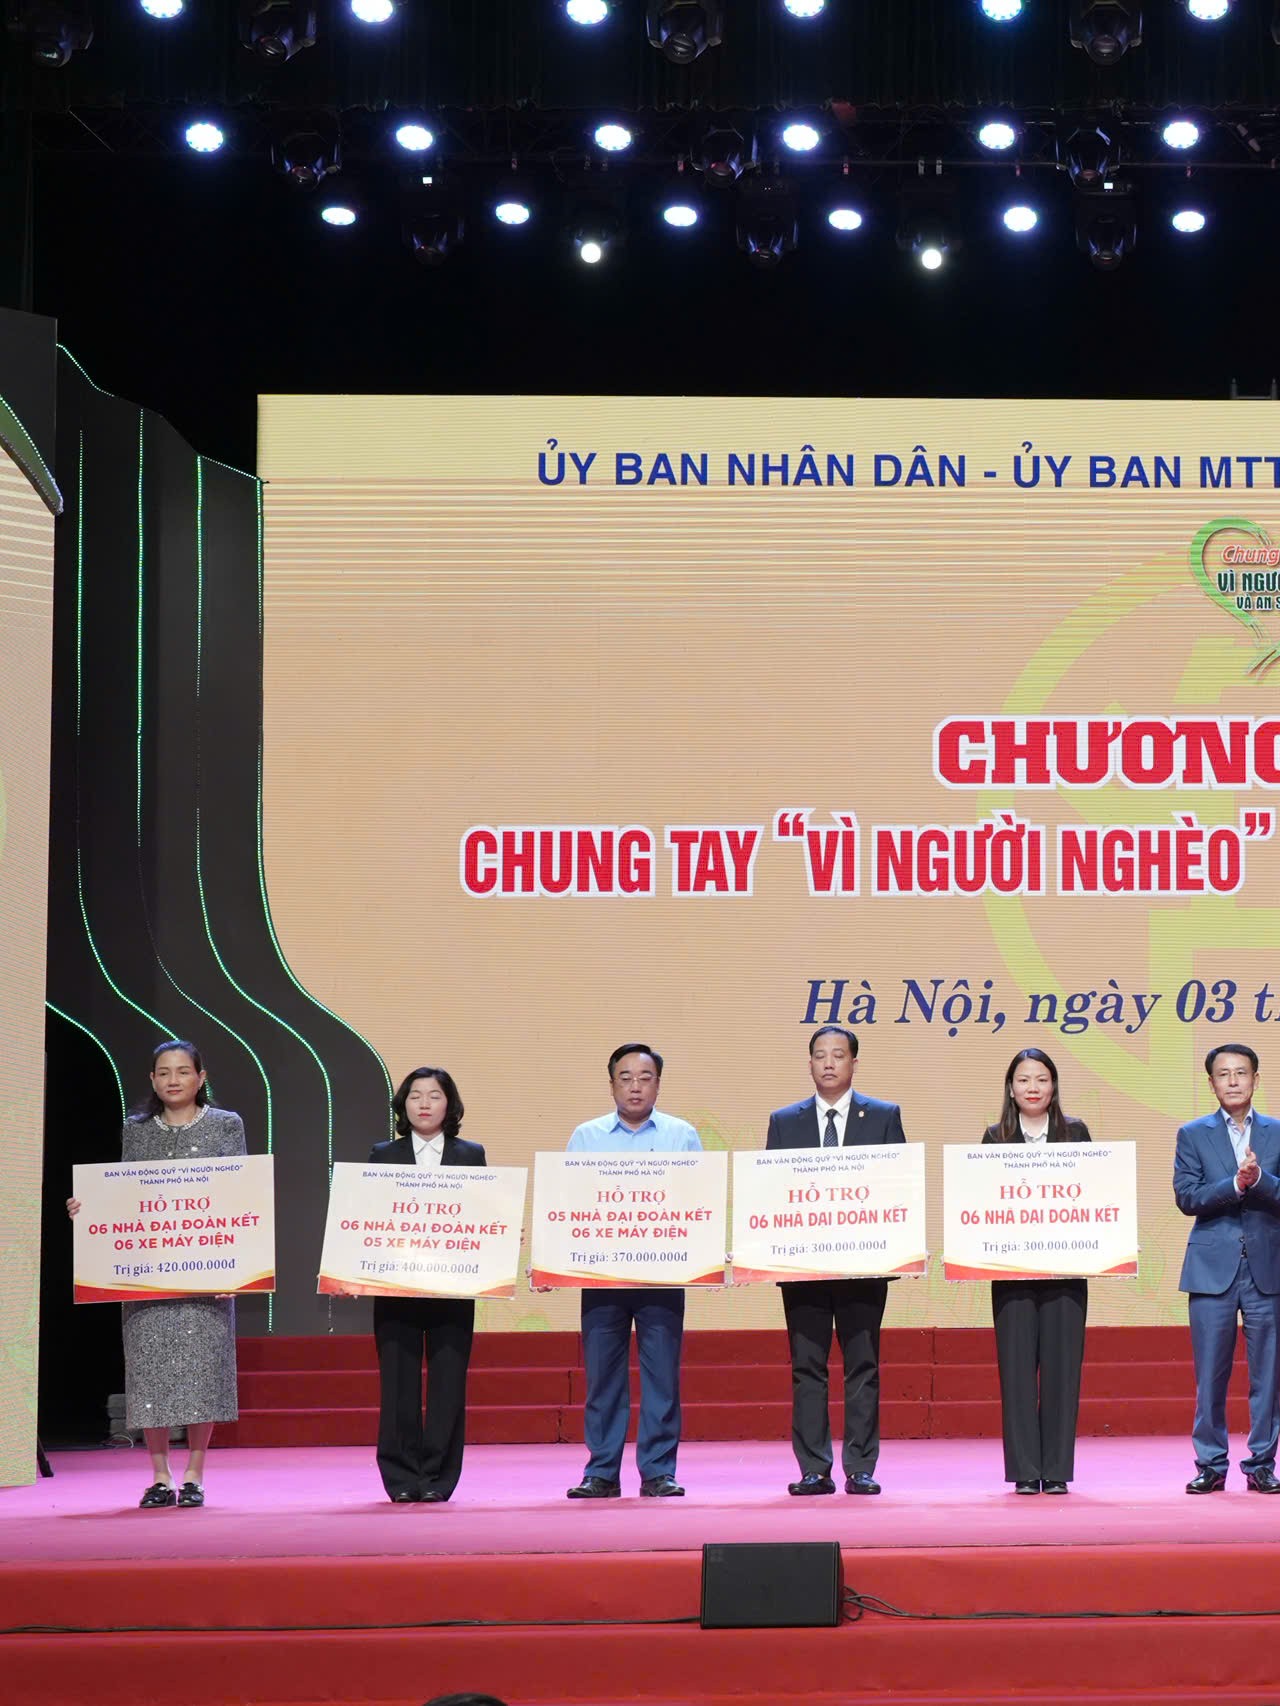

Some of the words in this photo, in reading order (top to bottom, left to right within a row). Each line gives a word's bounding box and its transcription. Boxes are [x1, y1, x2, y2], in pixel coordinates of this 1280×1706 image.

[538, 438, 597, 486] ỦY
[615, 452, 708, 486] BAN
[727, 444, 854, 486] NHÂN
[874, 445, 966, 487] DÂN
[1013, 441, 1072, 488] ỦY
[1089, 455, 1181, 488] BAN
[1222, 545, 1279, 565] Chung
[1217, 569, 1234, 592] VÌ
[1237, 594, 1252, 609] VÀ
[1257, 597, 1271, 609] AN
[463, 829, 651, 893] CHUNG
[669, 829, 757, 892] TAY
[877, 814, 1041, 894] NGƯỜI
[799, 979, 877, 1024] Hà
[895, 979, 1006, 1037] Nội,
[1024, 978, 1162, 1034] ngày
[1176, 979, 1237, 1023] 03
[598, 1185, 625, 1203] HỖ
[629, 1189, 666, 1205] TRỢ
[788, 1182, 820, 1203] HỖ
[825, 1185, 870, 1203] TRỢ
[1000, 1178, 1032, 1200] HỖ
[1037, 1182, 1082, 1201] TRỢ
[140, 1194, 167, 1213] HỖ
[172, 1196, 211, 1212] TRỢ
[392, 1197, 420, 1214] HỖ
[424, 1201, 462, 1218] TRỢ
[89, 1223, 107, 1235] 06
[113, 1219, 145, 1233] NHÀ
[150, 1219, 176, 1233] ĐẠI
[181, 1216, 226, 1230] ĐOÀN
[231, 1212, 259, 1227] KẾT
[548, 1211, 566, 1221] 05
[571, 1208, 601, 1221] NHÀ
[606, 1211, 632, 1224] ĐẠI
[637, 1208, 680, 1221] ĐOÀN
[685, 1206, 712, 1221] KẾT
[750, 1215, 768, 1230] 06
[774, 1210, 804, 1228] NHÀ
[883, 1203, 908, 1223] KẾT
[961, 1210, 980, 1225] 06
[985, 1207, 1015, 1224] NHÀ
[1095, 1203, 1120, 1222] KẾT
[341, 1220, 359, 1230] 06
[364, 1219, 395, 1231] NHÀ
[401, 1222, 426, 1233] ĐẠI
[431, 1221, 475, 1234] ĐOÀN
[480, 1220, 507, 1234] KẾT
[572, 1228, 590, 1238] 06
[596, 1227, 613, 1238] XE
[618, 1223, 649, 1238] MÁY
[653, 1224, 687, 1240] ĐIỆN
[114, 1239, 133, 1250] 06
[139, 1238, 157, 1249] XE
[162, 1233, 194, 1247] MÁY
[199, 1232, 234, 1247] ĐIỆN
[364, 1237, 382, 1247] 05
[387, 1237, 405, 1248] XE
[410, 1235, 440, 1249] MÁY
[445, 1237, 480, 1252] ĐIỆN
[114, 1264, 130, 1277] Trị
[133, 1263, 153, 1277] giá:
[157, 1258, 235, 1273] 420.000.000đ
[570, 1252, 587, 1265] Trị
[589, 1252, 609, 1264] giá:
[612, 1251, 688, 1262] 370.000.000đ
